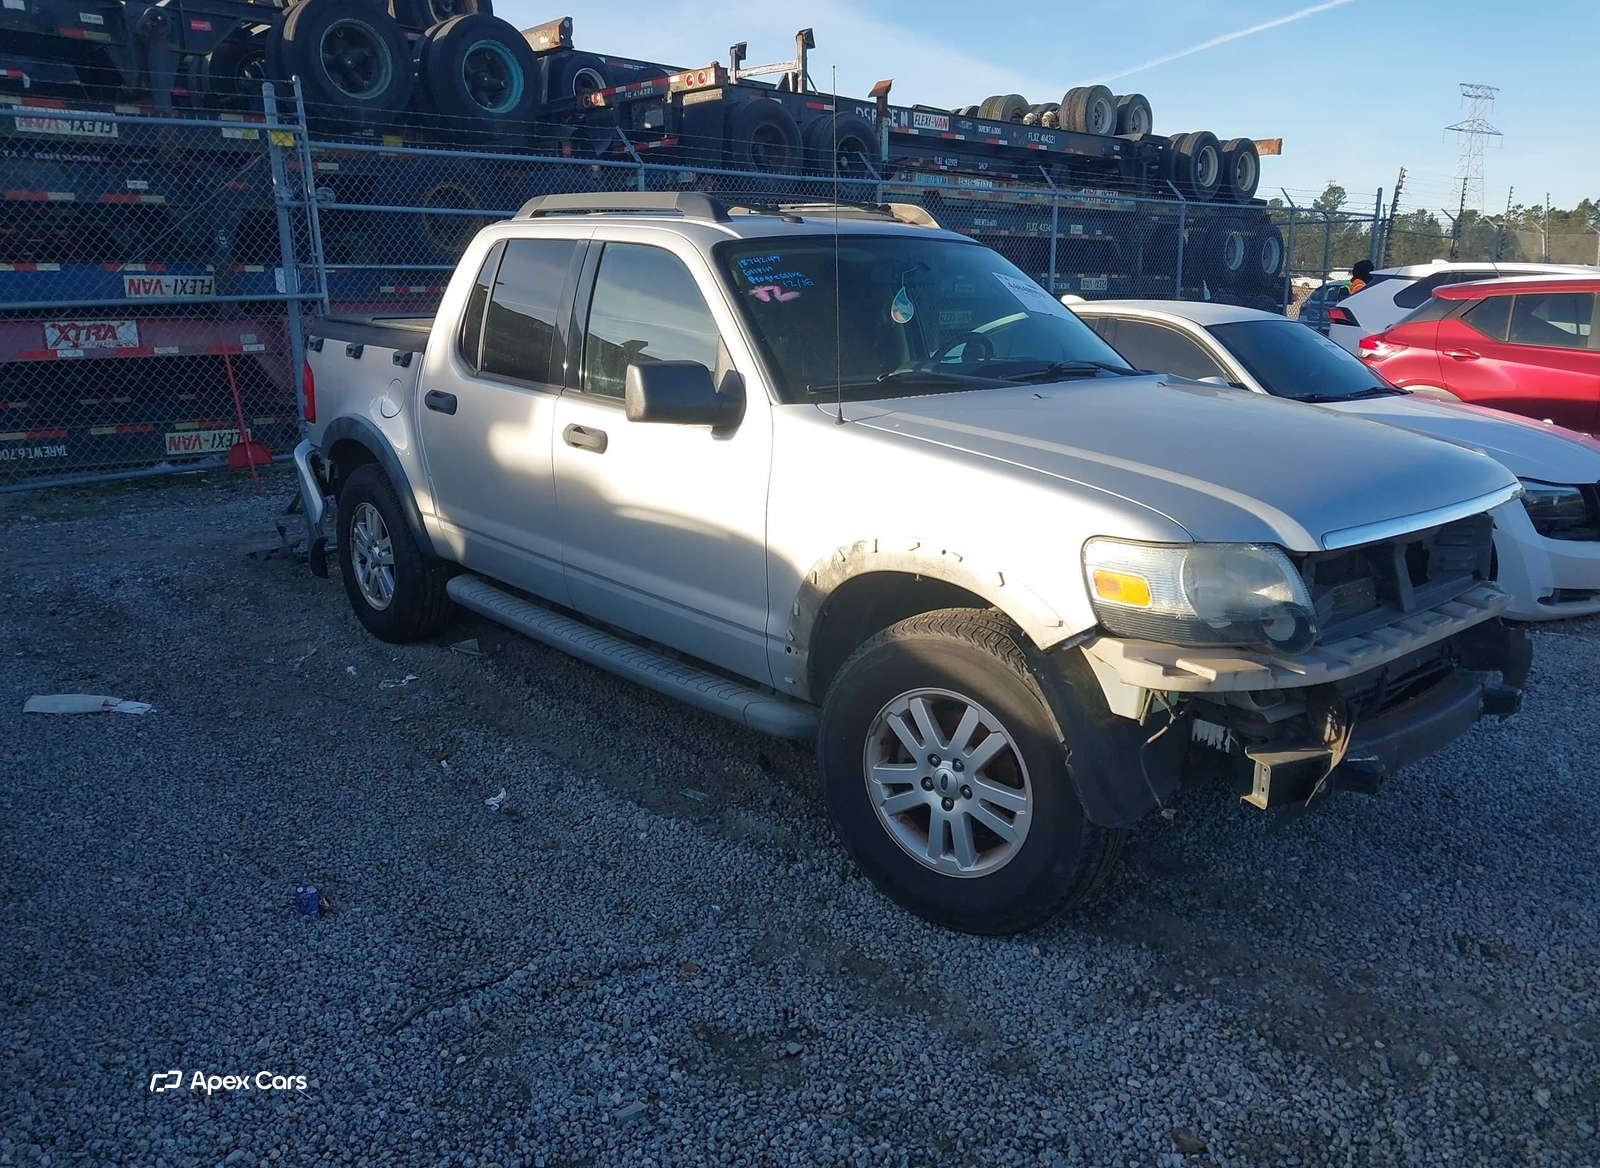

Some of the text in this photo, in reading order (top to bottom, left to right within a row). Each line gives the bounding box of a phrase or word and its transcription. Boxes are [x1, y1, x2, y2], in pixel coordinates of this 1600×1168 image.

[914, 113, 948, 130] FLEXI-VAN
[128, 279, 213, 295] FLEXI-VAN
[50, 322, 118, 349] XTRA
[168, 432, 248, 451] LEXI-VAN
